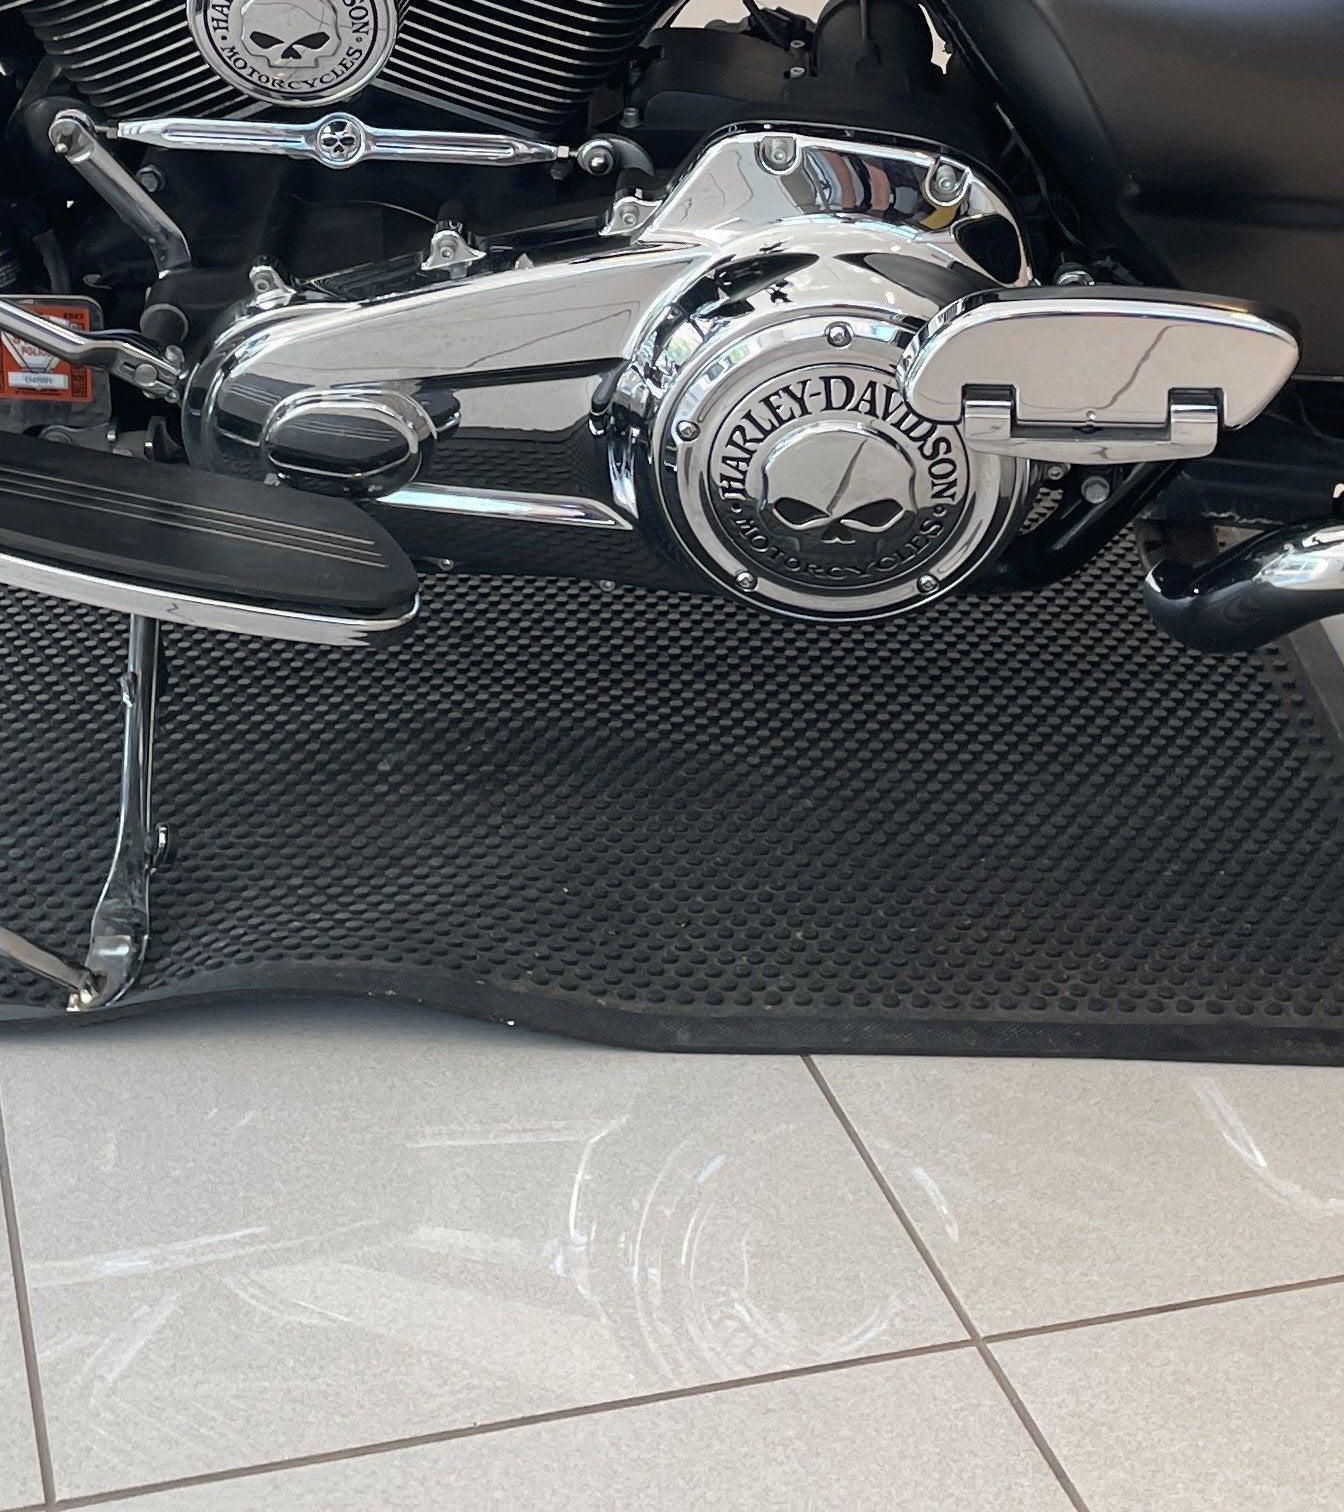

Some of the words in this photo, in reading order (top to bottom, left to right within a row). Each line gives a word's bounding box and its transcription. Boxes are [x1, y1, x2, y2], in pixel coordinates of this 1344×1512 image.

[220, 45, 363, 89] MOTORCYCLES
[719, 374, 958, 503] HARLEY-DAVIDSON
[733, 517, 944, 579] MOTORCYCLES
